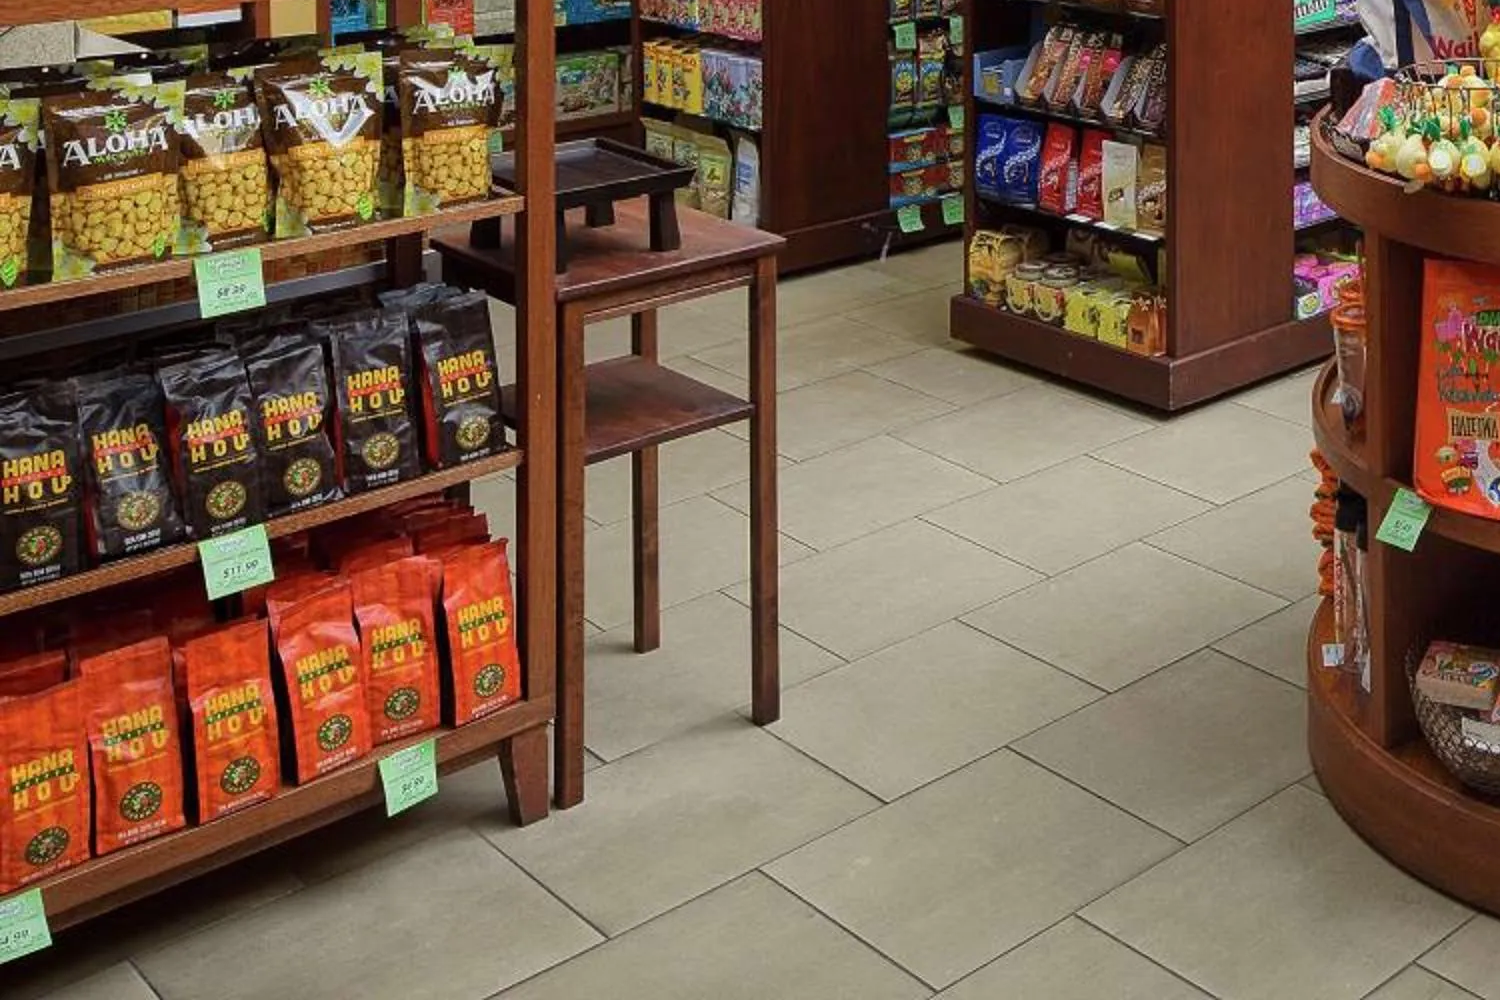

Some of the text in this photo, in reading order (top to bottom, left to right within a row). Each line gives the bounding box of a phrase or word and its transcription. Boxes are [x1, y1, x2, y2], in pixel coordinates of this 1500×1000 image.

[412, 80, 496, 115] ALOHA
[62, 125, 169, 168] ALOHA
[347, 364, 400, 390] HANA
[437, 350, 485, 377] HANA
[262, 391, 318, 418] HANA
[92, 423, 150, 450] HANA
[187, 409, 244, 438] HANA
[2, 450, 66, 478] HANA
[202, 682, 261, 716] HANA
[102, 704, 164, 737] HANA
[10, 747, 74, 783] HANA
